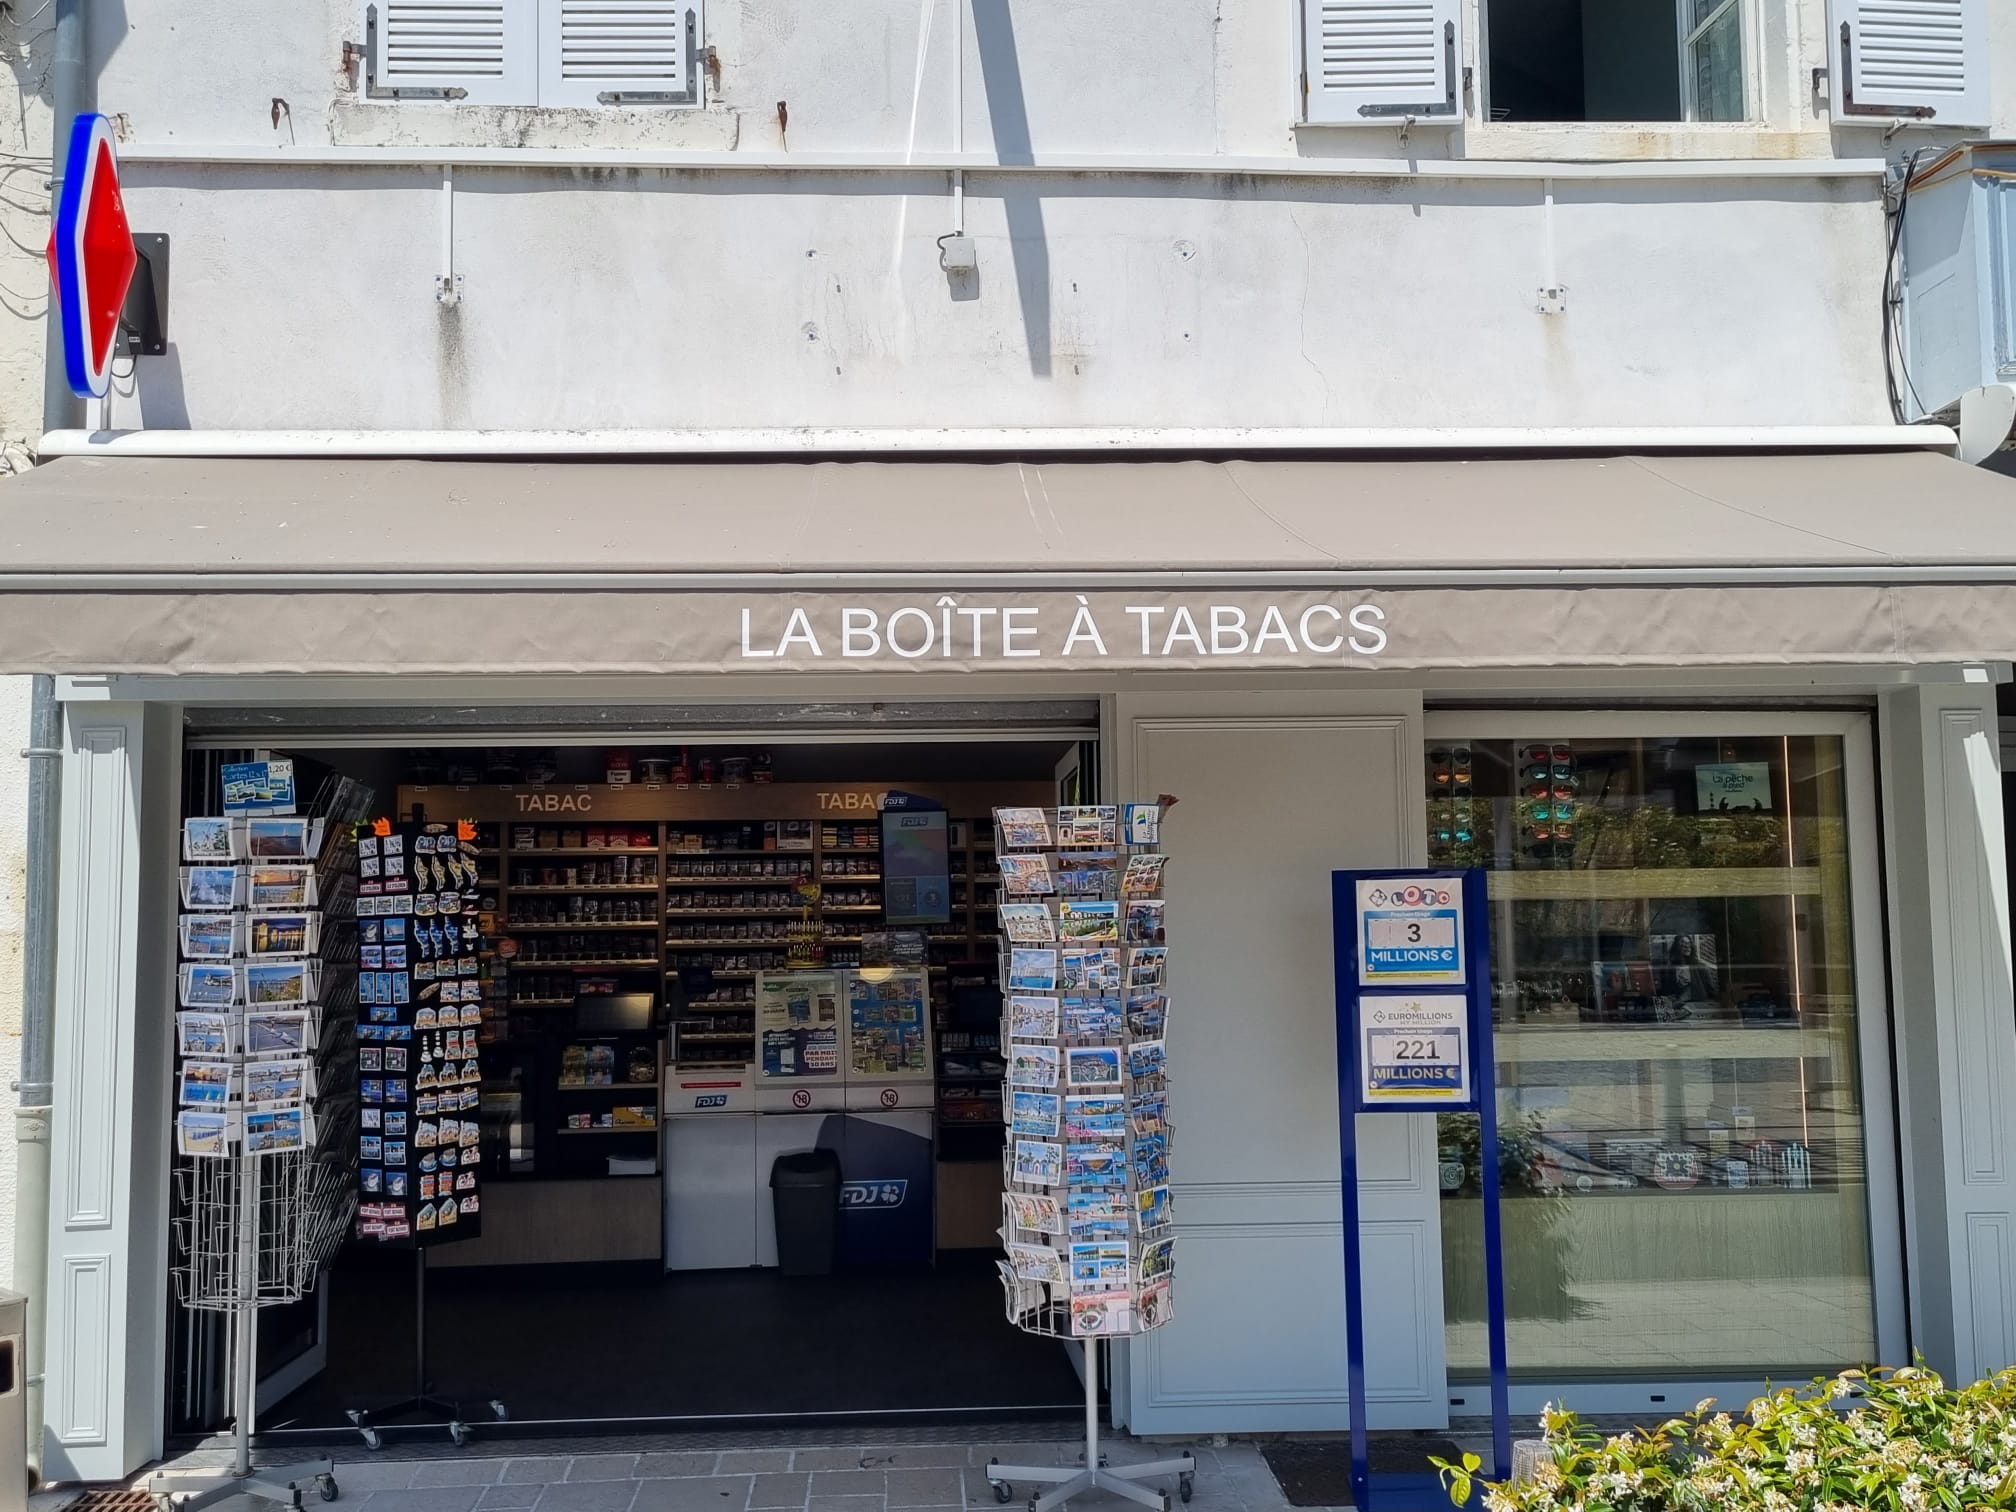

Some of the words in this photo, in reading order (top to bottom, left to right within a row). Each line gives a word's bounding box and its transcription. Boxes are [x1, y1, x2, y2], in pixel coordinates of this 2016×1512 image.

[740, 607, 823, 658] LA
[840, 596, 1040, 657] BOÎTE
[1061, 595, 1108, 655] À
[1125, 603, 1388, 655] TABACS
[268, 765, 284, 774] 1,20
[514, 794, 592, 812] TABAC
[1391, 885, 1450, 907] LOTO
[1407, 923, 1422, 943] 3
[1371, 950, 1440, 963] MILLIONS
[1441, 949, 1454, 962] €
[1388, 1012, 1454, 1021] EUROMILLIONS
[1396, 1040, 1441, 1060] 221
[1373, 1067, 1444, 1080] MILLIONS
[1445, 1068, 1456, 1079] €
[697, 1096, 716, 1107] FDJ
[840, 1186, 877, 1205] FDJ
